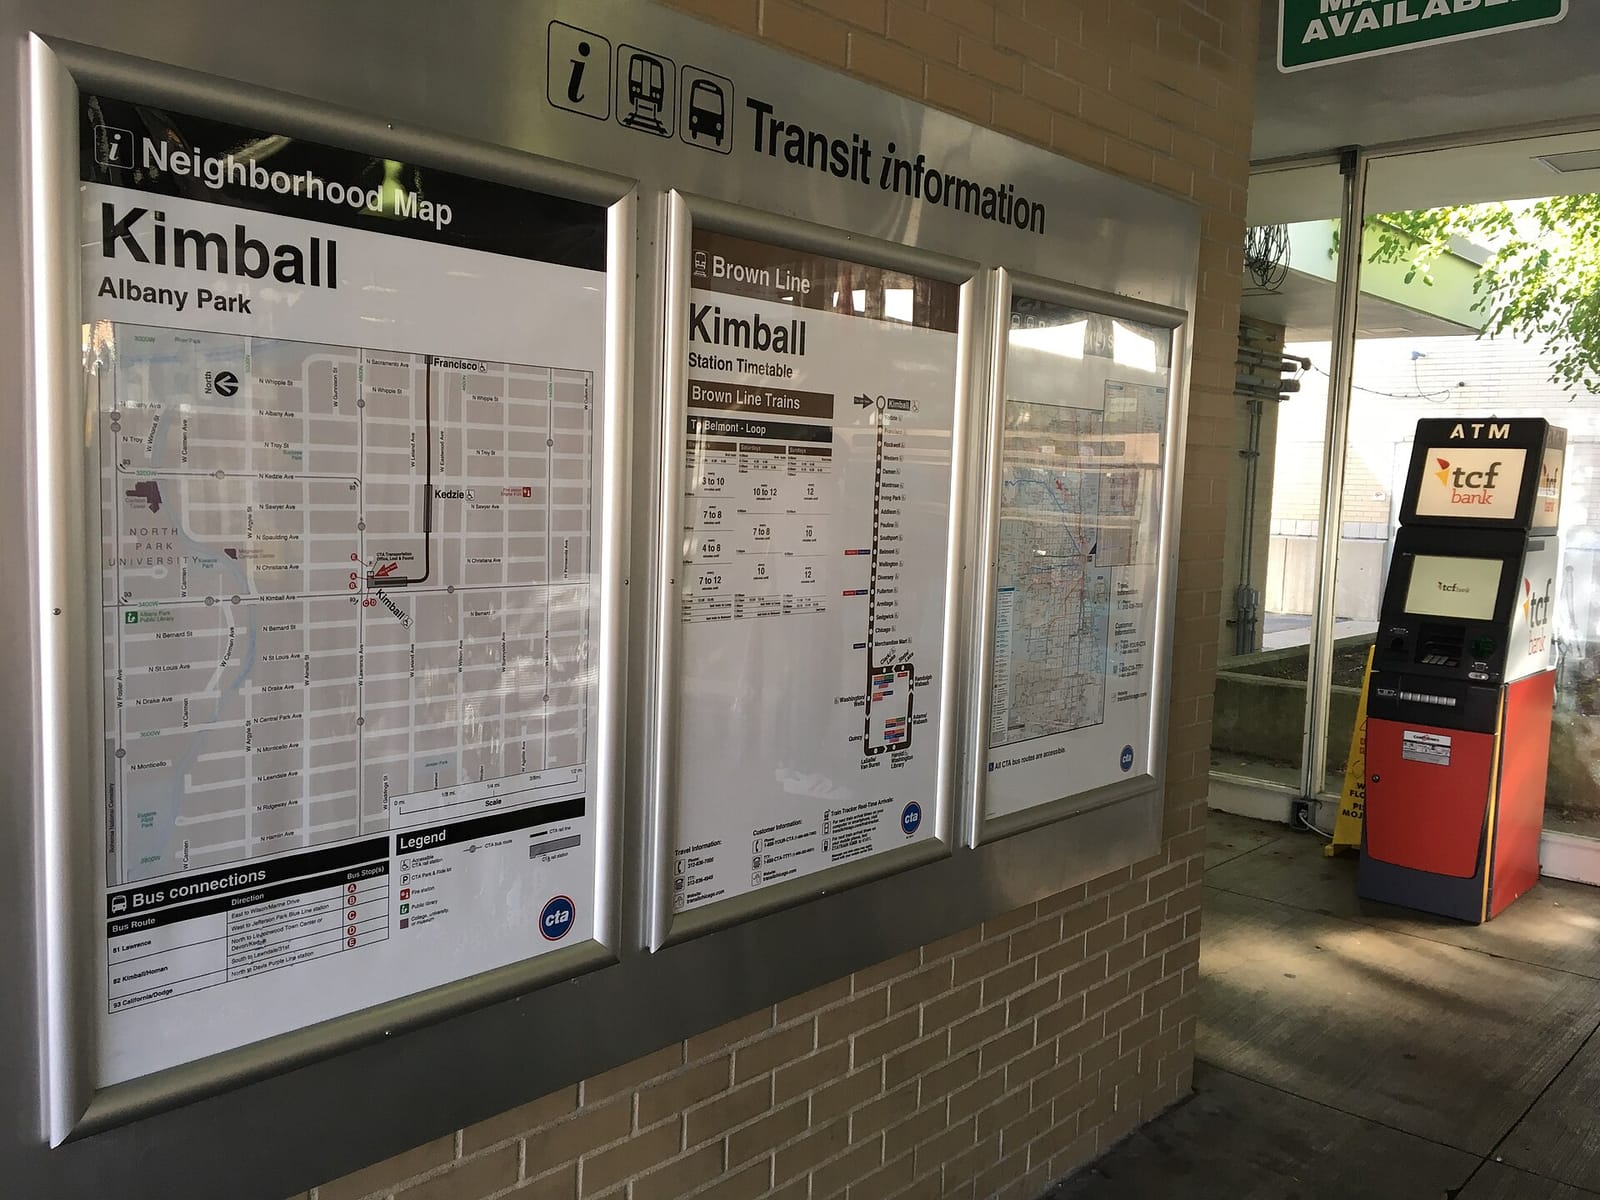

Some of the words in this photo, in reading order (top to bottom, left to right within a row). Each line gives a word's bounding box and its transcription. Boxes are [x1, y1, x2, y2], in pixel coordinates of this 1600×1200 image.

[746, 97, 872, 184] Transit
[880, 142, 1046, 234] information
[142, 136, 384, 212] Neighborhood
[394, 190, 453, 230] Map
[101, 202, 338, 289] Kimball
[712, 255, 770, 287] Brown
[775, 268, 810, 294] Line
[98, 276, 188, 311] Albany
[197, 287, 252, 314] Park
[688, 302, 806, 356] Kimball
[434, 358, 478, 371] Francisco
[688, 352, 733, 372] Station
[736, 358, 793, 378] Timetable
[692, 386, 732, 403] Brown
[736, 390, 761, 406] Line
[765, 392, 800, 409] Trains
[704, 420, 738, 433] Belmont
[746, 422, 766, 436] Loop
[1450, 424, 1510, 439] ATM
[708, 477, 714, 486] to
[1452, 462, 1502, 488] tcf
[435, 490, 464, 499] Kedzie
[1451, 488, 1493, 505] bank
[130, 528, 179, 536] NORTH
[109, 556, 198, 567] UNIVERSITY
[1442, 582, 1456, 592] tcf
[375, 588, 405, 620] Kimball
[1530, 578, 1552, 628] tcf
[262, 744, 288, 752] Monticello
[1002, 759, 1012, 768] CTA
[1012, 757, 1021, 765] bus
[1022, 755, 1035, 763] routes
[1122, 753, 1132, 763] cta
[1350, 790, 1365, 798] FLO
[905, 812, 918, 824] cta
[1342, 809, 1362, 818] MOJ
[753, 827, 775, 836] Customer
[777, 819, 802, 830] Information:
[400, 830, 446, 850] Legend
[675, 847, 691, 856] Travel
[691, 841, 722, 851] Information:
[361, 866, 384, 878] Stop(s)
[132, 891, 165, 907] Bus
[170, 870, 266, 899] connections
[231, 893, 264, 906] Direction
[112, 923, 129, 932] Bus
[131, 918, 156, 928] Route
[545, 909, 569, 927] cta
[231, 923, 245, 931] West
[122, 940, 152, 952] Lawrence
[122, 965, 168, 982] Kimball/Homan
[122, 988, 173, 1006] California/Dodge
